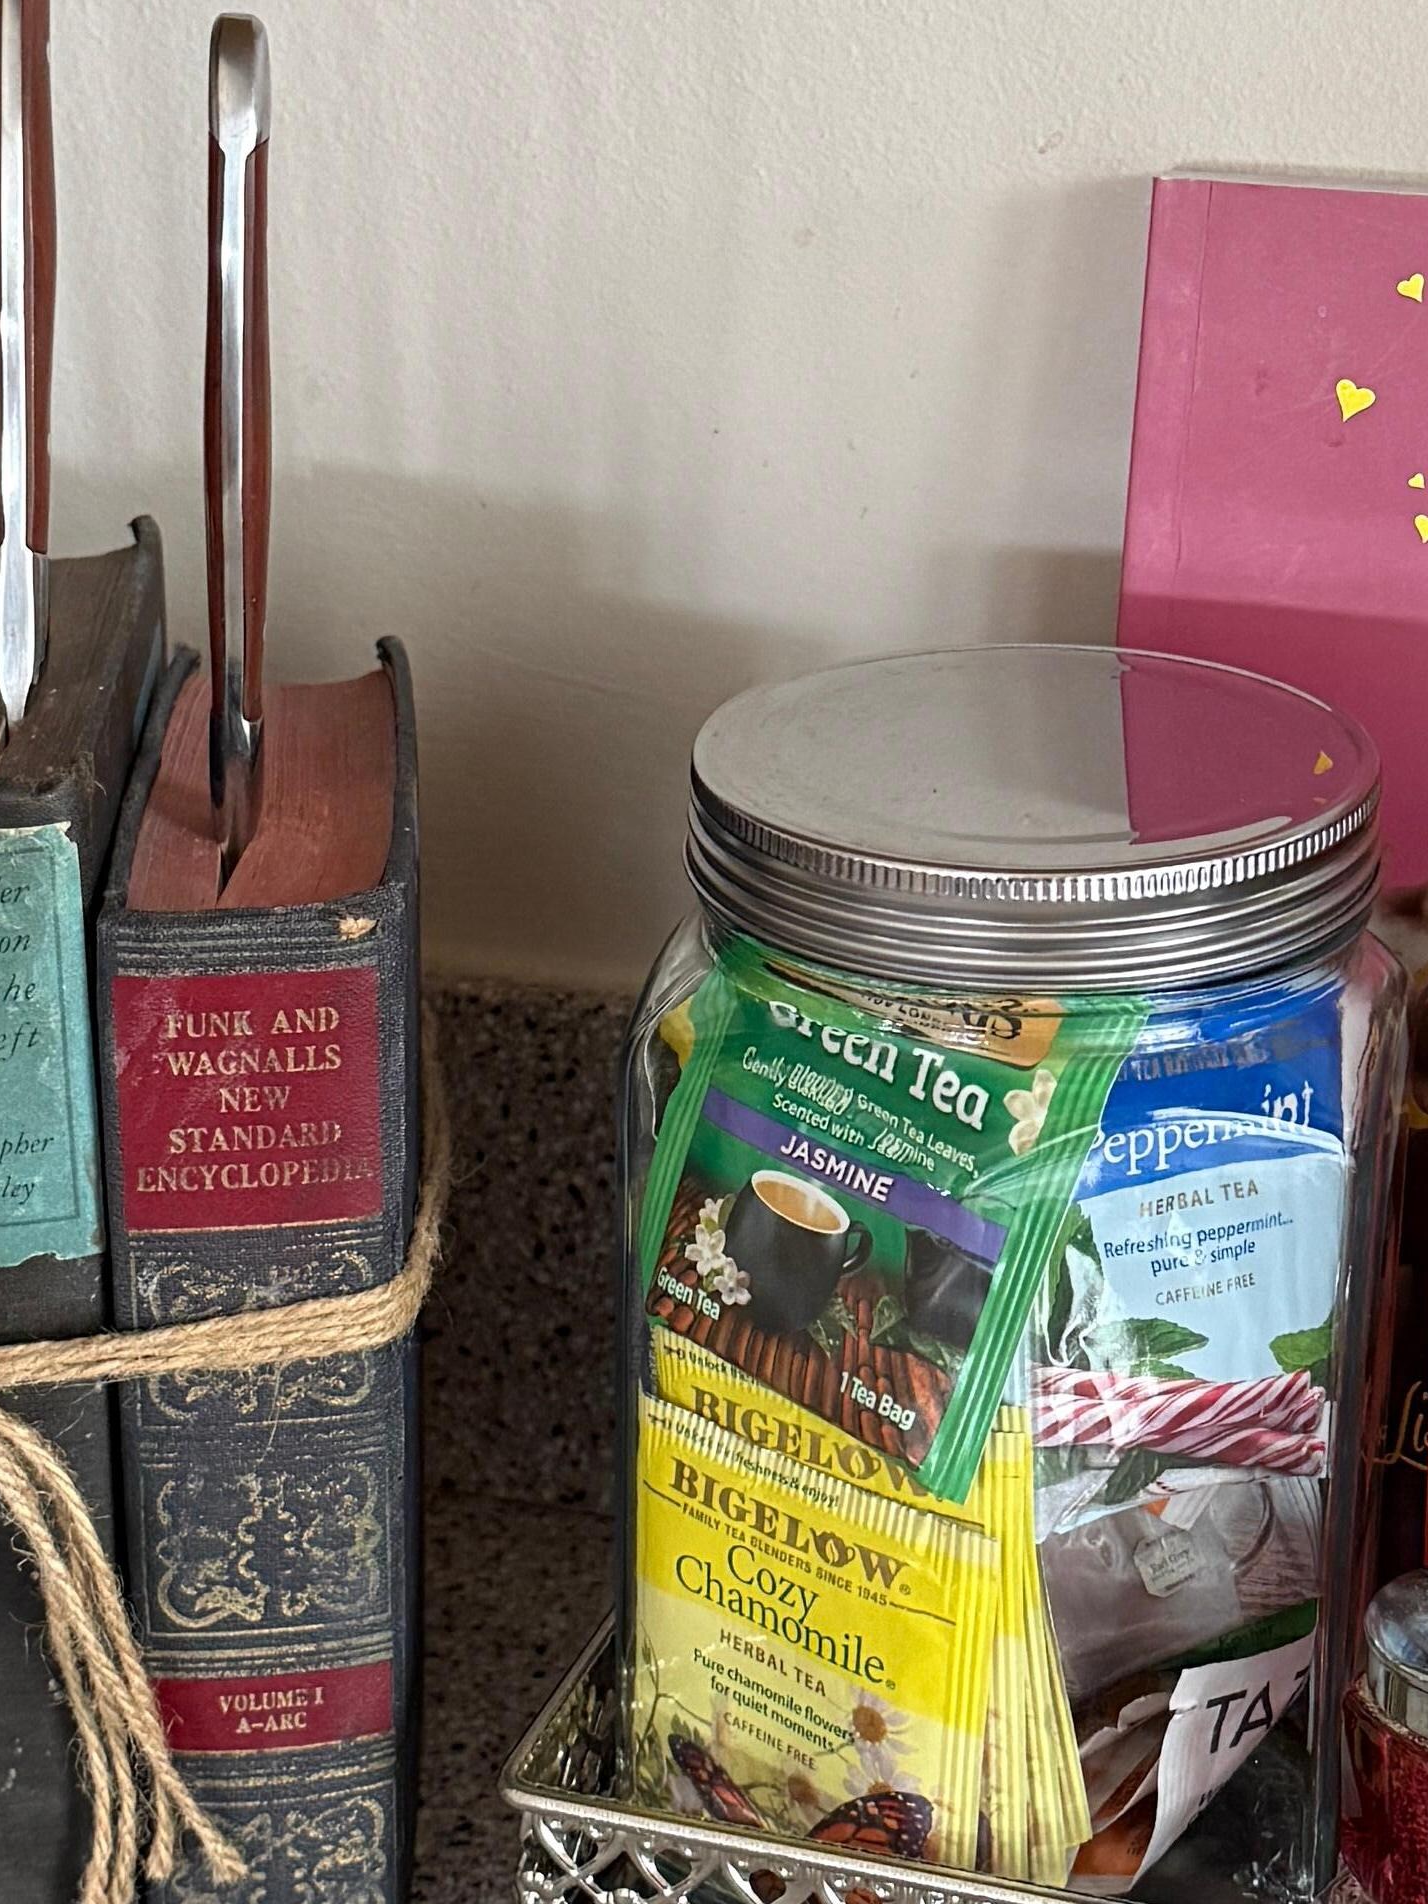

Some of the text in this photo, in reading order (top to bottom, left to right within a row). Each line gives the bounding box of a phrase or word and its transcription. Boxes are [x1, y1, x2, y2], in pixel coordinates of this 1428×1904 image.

[166, 1005, 341, 1040] FUNK AND
[167, 1044, 343, 1078] WAGNALLS
[909, 1046, 989, 1131] Tea
[218, 1084, 292, 1114] NEW
[742, 1046, 788, 1088] Gently
[858, 1094, 898, 1127] Green
[902, 1116, 925, 1144] Tea
[927, 1133, 979, 1180] Leaves,
[773, 1093, 830, 1130] Scented
[831, 1119, 865, 1147] with
[168, 1120, 343, 1156] STANDARD
[136, 1157, 373, 1192] ENCYCLOPEDIA
[780, 1135, 895, 1202] JASMINE
[1138, 1179, 1259, 1218] HERBAL TEA
[1103, 1231, 1192, 1259] Refreshing
[1151, 1254, 1189, 1277] pure
[1210, 1239, 1256, 1264] simple
[656, 1266, 721, 1321] Green Tea
[1155, 1272, 1256, 1306] CAFFEINE FREE
[840, 1371, 917, 1431] 1 Tea Bag
[669, 1456, 910, 1589] BIGELOW
[682, 1503, 887, 1606] FAMILY TEA BLENDERS SINCE 1945
[728, 1545, 820, 1624] Cozy
[676, 1555, 886, 1684] Chamomile
[720, 1629, 826, 1696] HERBAL TEA
[219, 1686, 324, 1714] VOLUME I
[694, 1648, 855, 1744] Pure chamomile flowers
[711, 1676, 836, 1753] for quiet moments
[723, 1712, 816, 1771] CAFFEINE FREE
